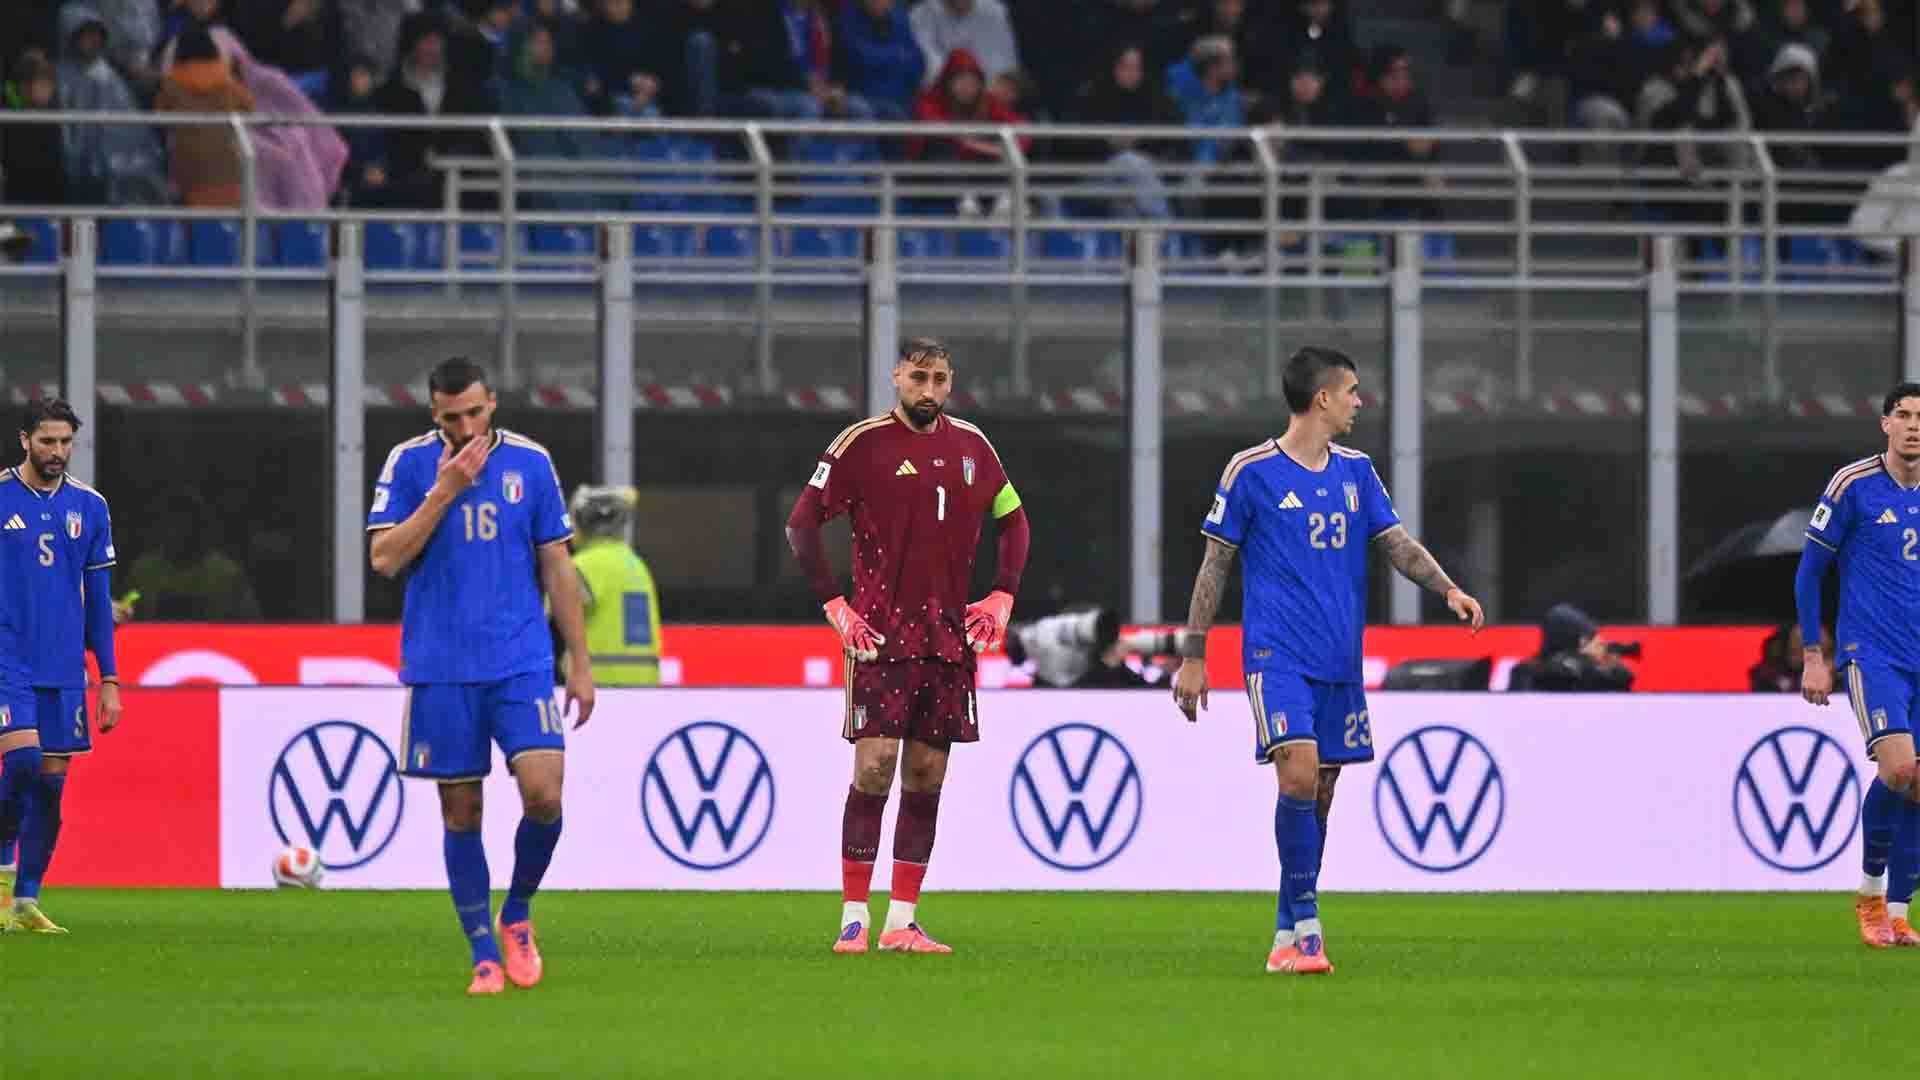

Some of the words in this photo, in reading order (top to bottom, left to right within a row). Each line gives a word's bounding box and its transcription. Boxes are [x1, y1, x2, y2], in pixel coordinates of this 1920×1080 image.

[461, 502, 499, 542] 16
[936, 485, 946, 521] 1
[1308, 511, 1347, 550] 23
[38, 532, 55, 568] 5
[1343, 708, 1372, 749] 23
[275, 726, 398, 852] VW
[648, 727, 770, 853] VW
[1014, 728, 1138, 853] VW
[1380, 731, 1501, 855] VW
[1740, 732, 1856, 854] VW
